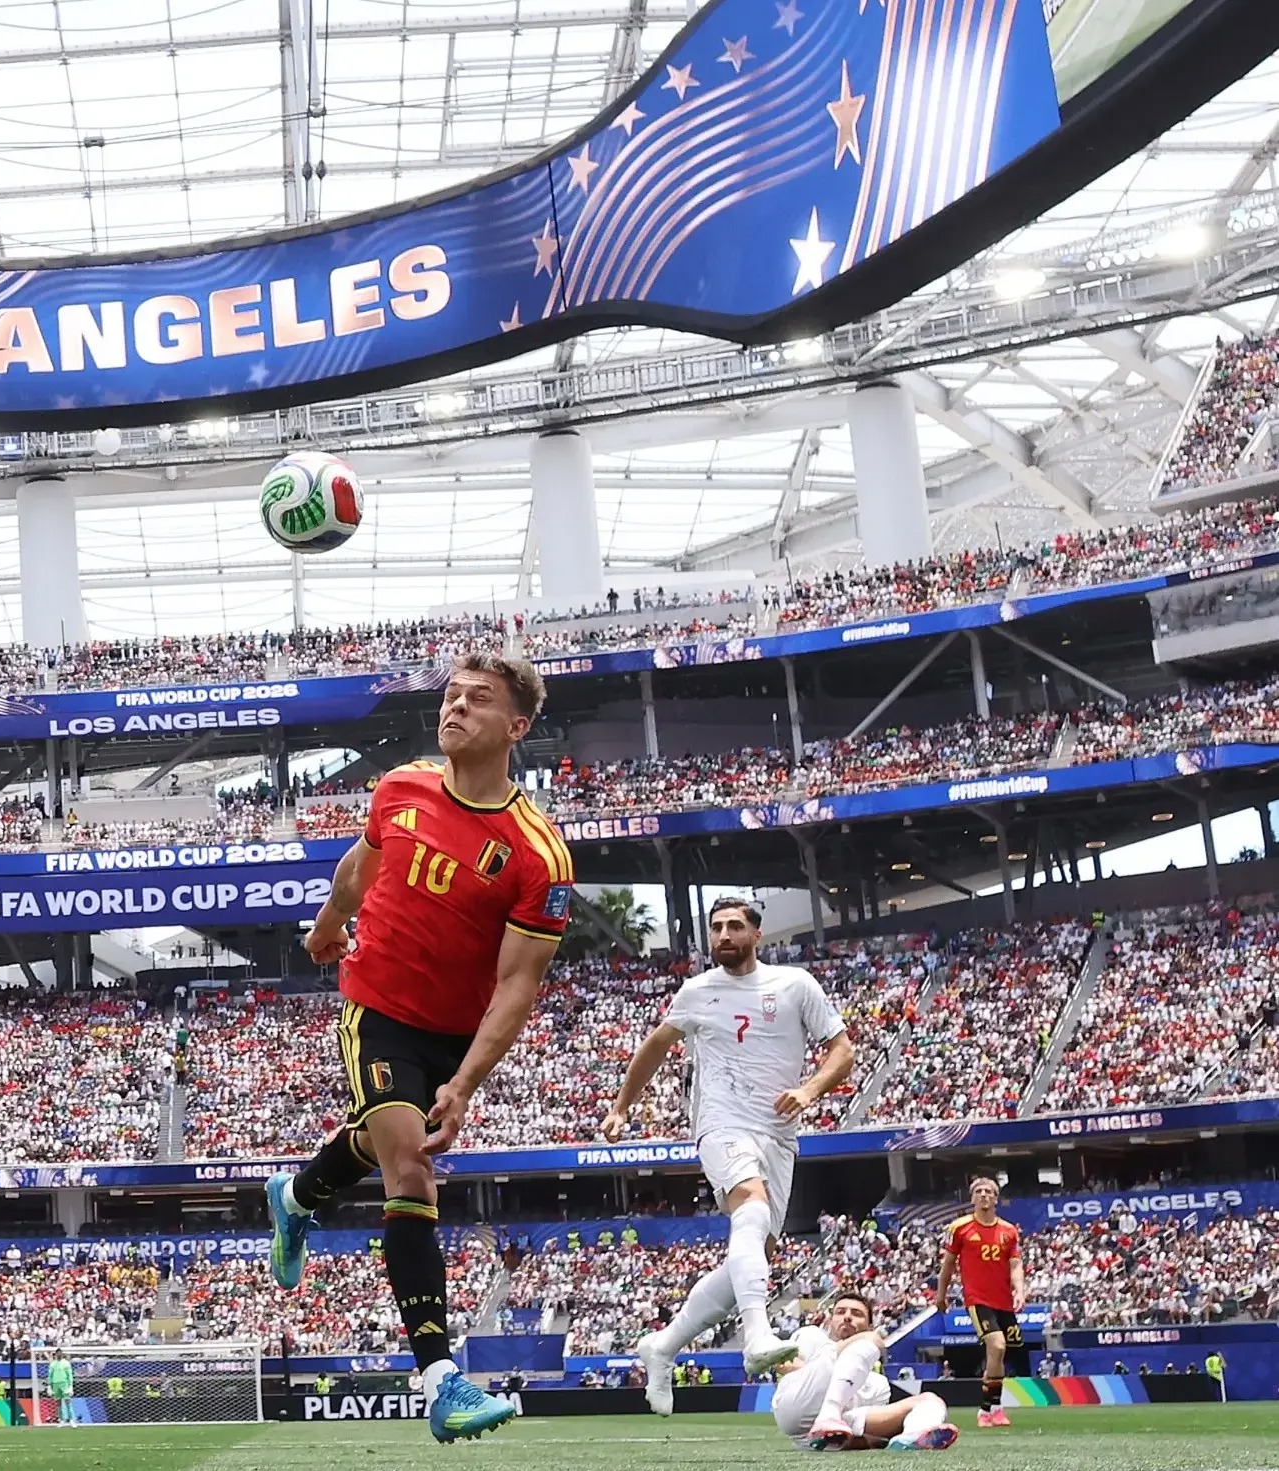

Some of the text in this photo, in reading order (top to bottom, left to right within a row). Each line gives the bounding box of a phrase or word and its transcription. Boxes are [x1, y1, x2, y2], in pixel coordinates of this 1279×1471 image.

[534, 659, 593, 676] GELES
[116, 684, 298, 707] FIFA WORLD CUP 2026
[49, 708, 281, 736] LOS ANGELES
[949, 776, 1047, 801] #FIFAWorldCup
[563, 816, 660, 841] NGELES
[46, 842, 305, 872] FIFA WORLD CUP 2026
[406, 841, 460, 895] 10
[43, 887, 166, 915] WORLD
[171, 883, 239, 910] CUP
[244, 878, 332, 908] 202
[734, 1015, 751, 1043] 7
[1049, 1112, 1162, 1135] LOS ANGELES
[578, 1150, 612, 1165] FIFA
[612, 1148, 668, 1163] WORLD
[195, 1166, 226, 1179] LOS
[1047, 1190, 1243, 1219] LOS ANGELES
[220, 1238, 272, 1256] 202
[981, 1244, 1001, 1261] 22
[1098, 1330, 1180, 1345] LOS ANGELES
